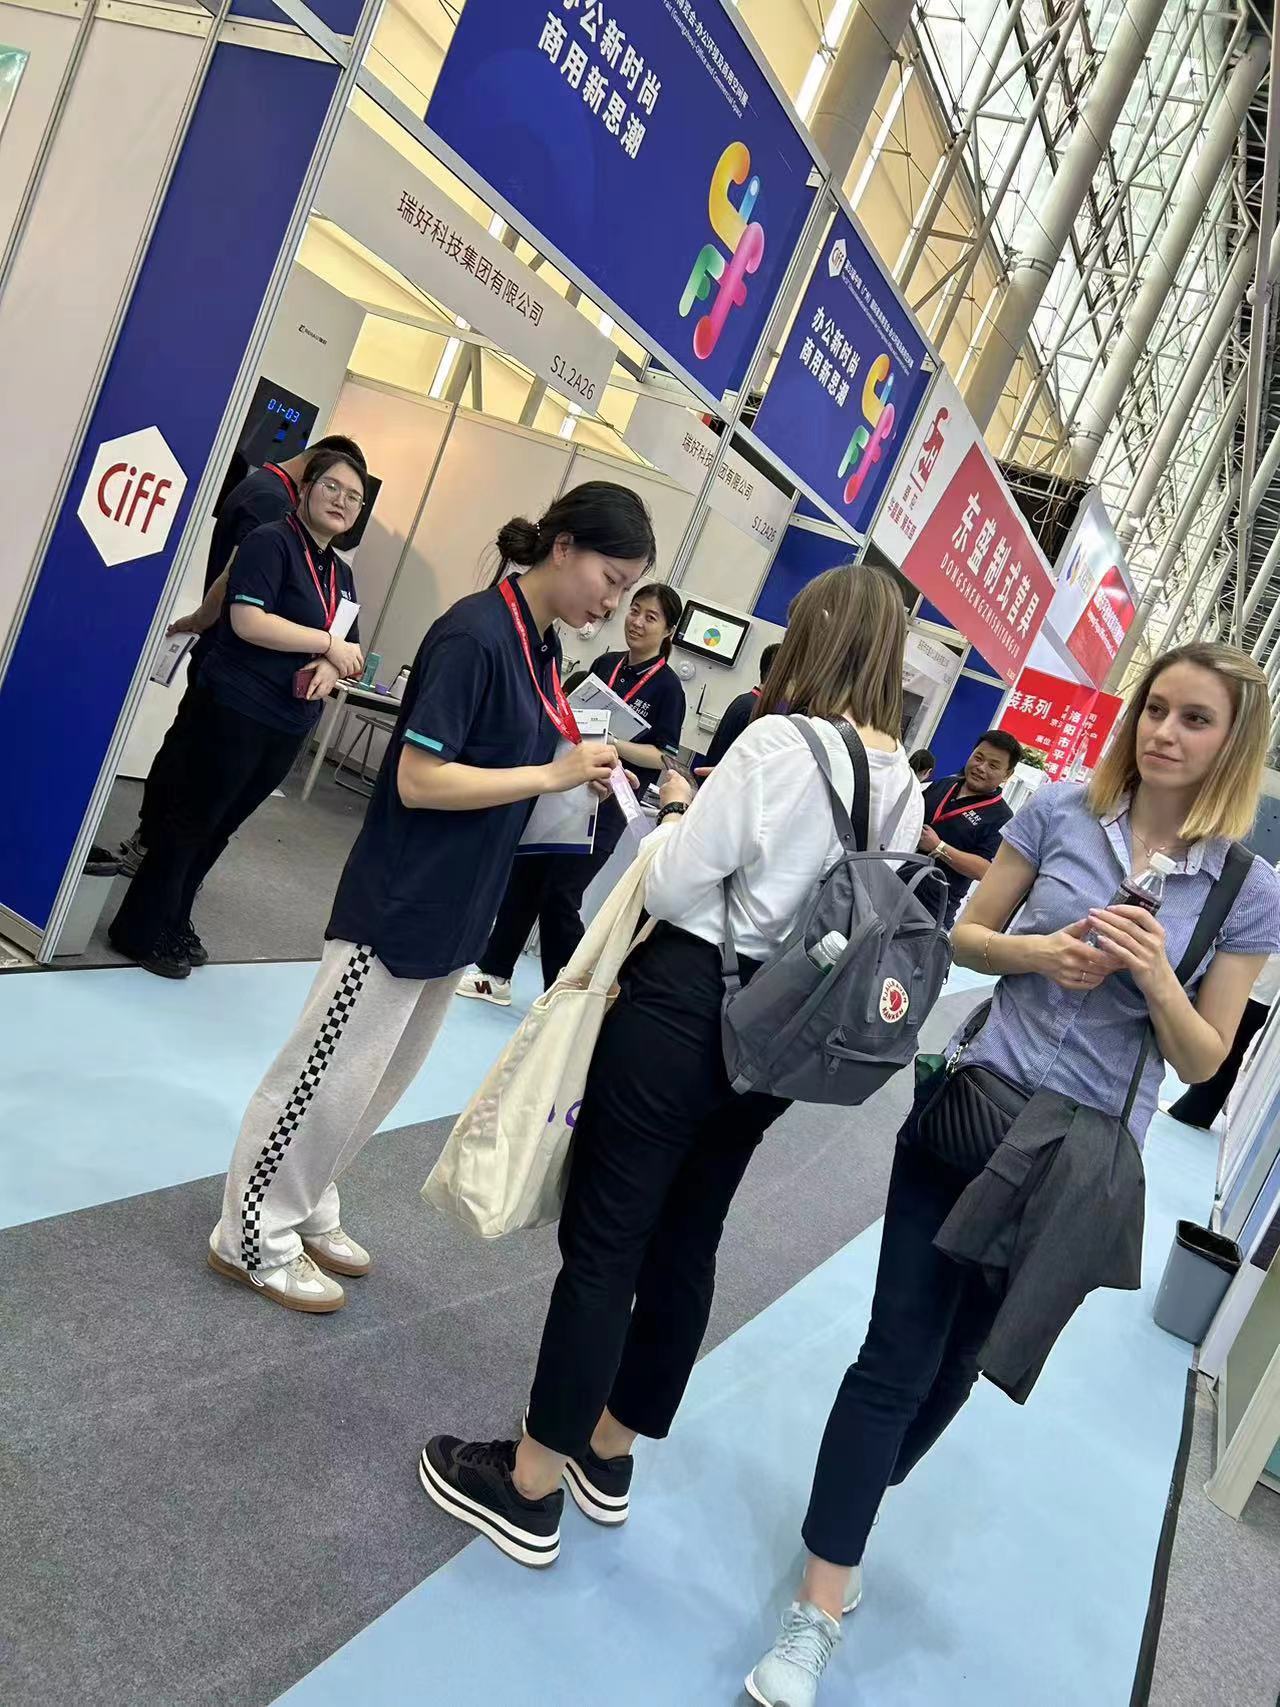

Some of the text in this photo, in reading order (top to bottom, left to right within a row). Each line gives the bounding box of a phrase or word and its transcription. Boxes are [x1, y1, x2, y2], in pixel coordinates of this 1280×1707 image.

[538, 11, 646, 159] 商用新思潮
[396, 190, 545, 328] 瑞好科技集团有限公司
[550, 353, 596, 402] S1.2A26
[799, 336, 850, 407] 商用新思潮
[811, 306, 860, 378] 办公新时尚
[268, 399, 300, 423] 01-03
[751, 515, 777, 543] S1.2A26
